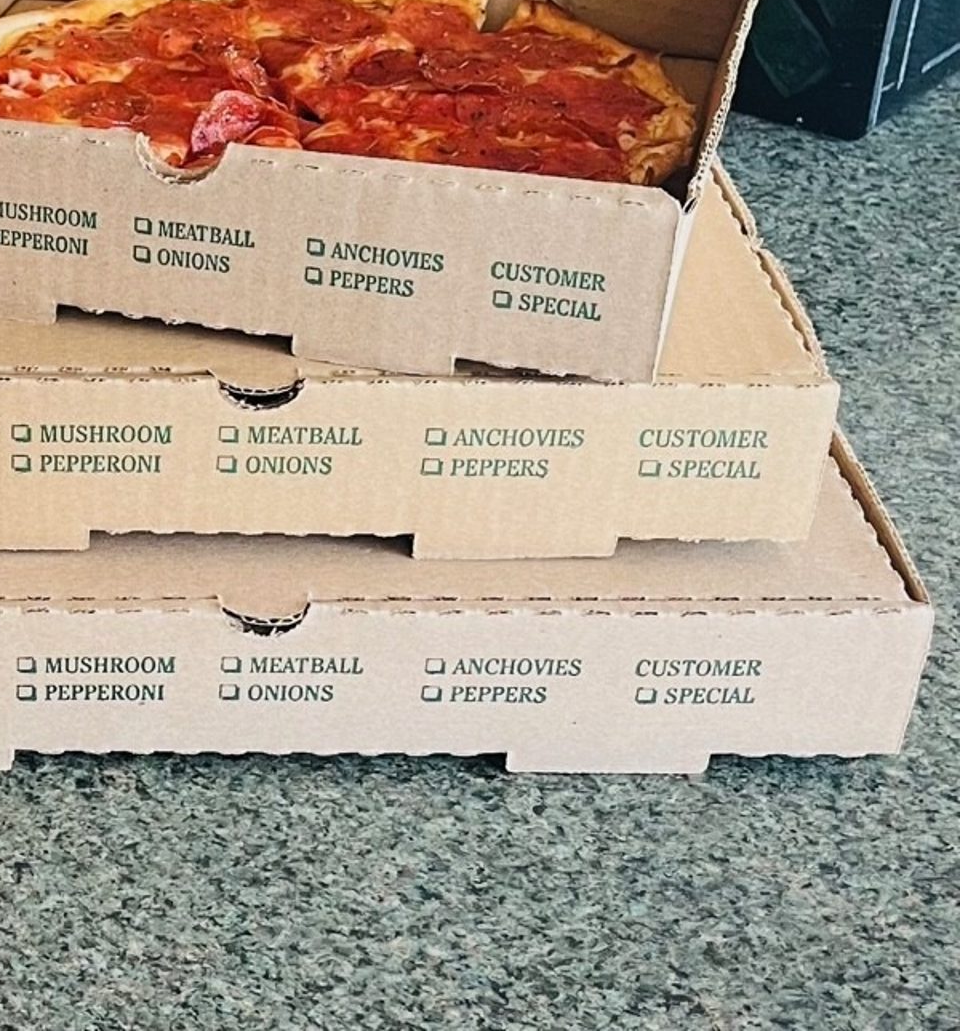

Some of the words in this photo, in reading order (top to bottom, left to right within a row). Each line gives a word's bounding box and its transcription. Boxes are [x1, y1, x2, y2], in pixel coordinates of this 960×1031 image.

[157, 220, 255, 248] MEATBALL
[157, 248, 230, 273] ONIONS
[330, 242, 444, 272] ANCHOVIES
[329, 270, 415, 297] PEPPERS
[490, 260, 606, 292] CUSTOMER
[518, 293, 602, 321] SPECIAL
[40, 424, 172, 444] MUSHROOM
[247, 426, 363, 446] MEATBALL
[453, 428, 585, 448] ANCHOVIES
[640, 429, 768, 449] CUSTOMER
[40, 454, 161, 473] PEPPERONI
[245, 456, 333, 476] ONIONS
[450, 458, 549, 478] PEPPERS
[667, 459, 761, 479] SPECIAL
[44, 656, 176, 675] MUSHROOM
[249, 657, 364, 675] MEATBALL
[452, 658, 583, 677] ANCHOVIES
[635, 659, 762, 678] CUSTOMER
[44, 684, 165, 703] PEPPERONI
[247, 684, 334, 702] ONIONS
[450, 685, 547, 704] PEPPERS
[663, 686, 755, 705] SPECIAL
